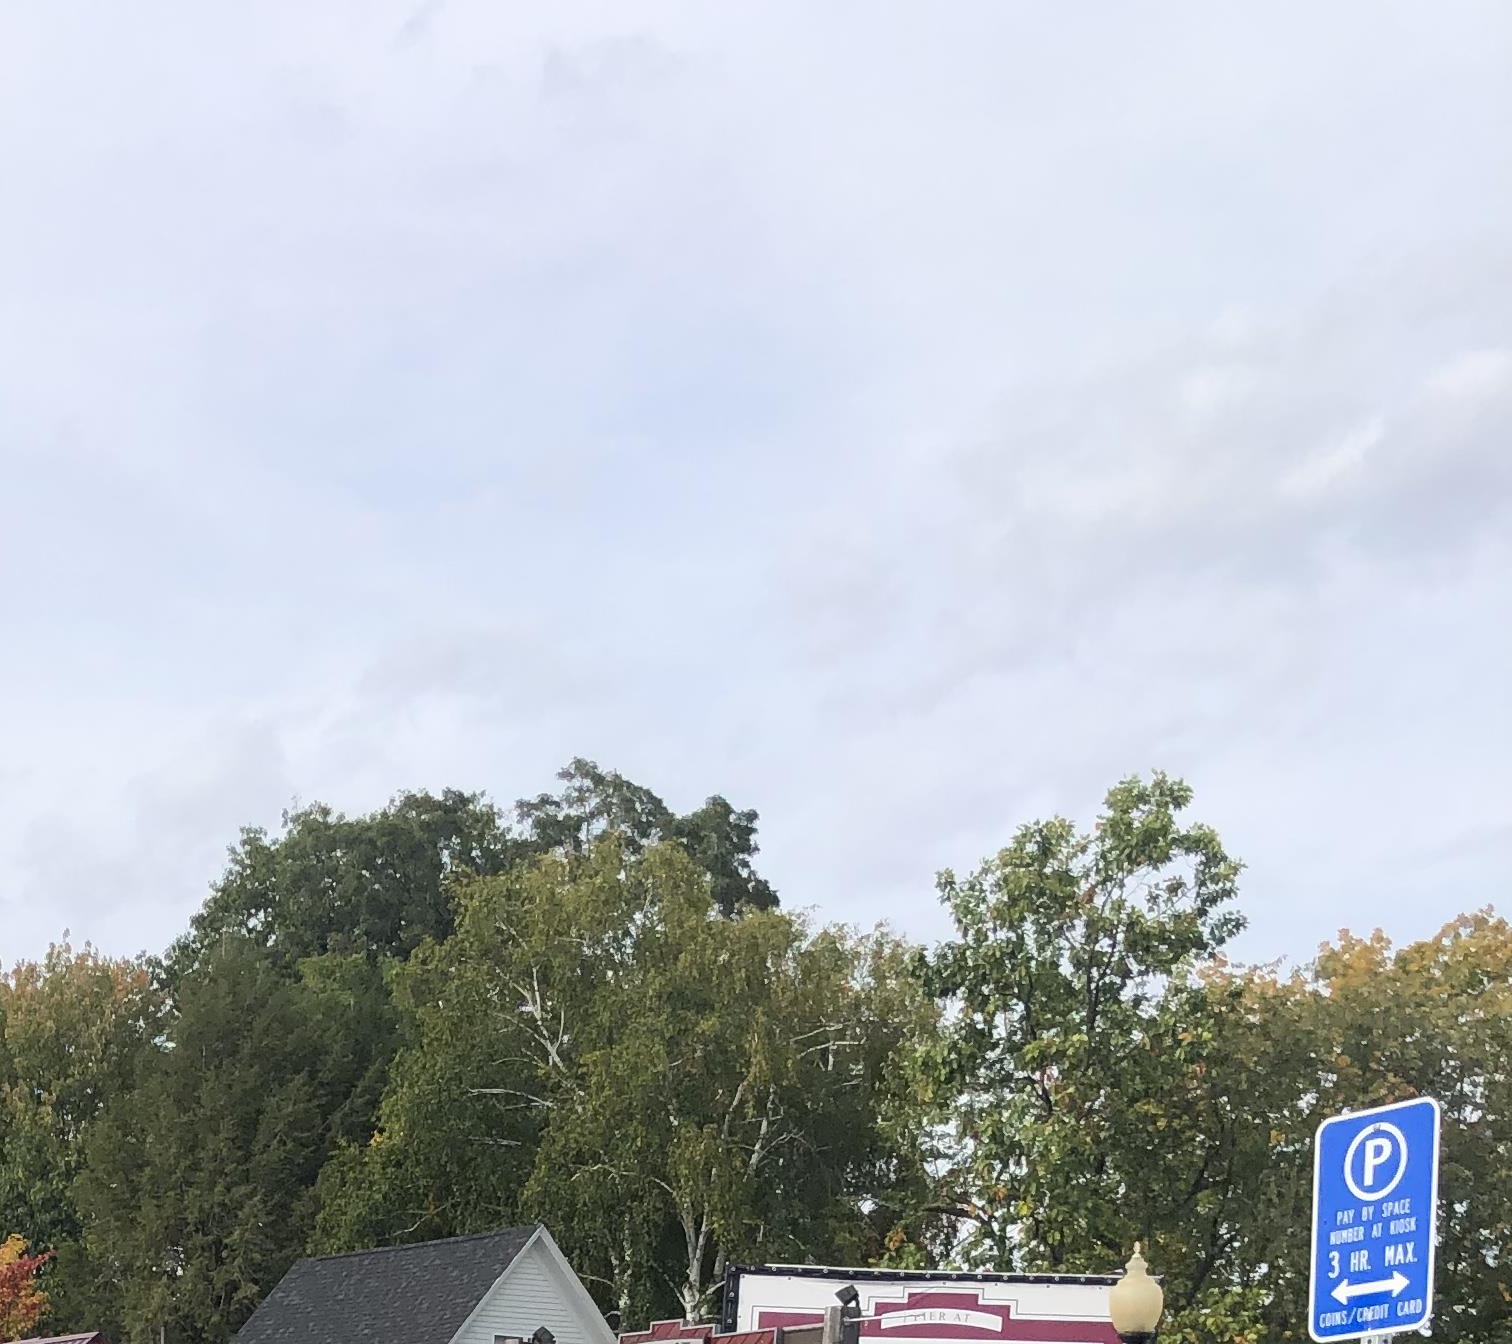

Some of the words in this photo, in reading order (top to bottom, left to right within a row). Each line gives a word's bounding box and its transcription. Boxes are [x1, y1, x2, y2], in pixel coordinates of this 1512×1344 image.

[1363, 1137, 1393, 1186] P
[1337, 1209, 1355, 1226] PAY
[1361, 1205, 1375, 1221] BY
[1382, 1199, 1411, 1218] SPACE
[1330, 1226, 1365, 1246] NUMBER
[1371, 1222, 1383, 1238] AT
[1390, 1217, 1417, 1235] KIOSK
[1328, 1250, 1341, 1278] 3
[1350, 1249, 1372, 1272] HR.
[1384, 1241, 1418, 1267] MAX.
[954, 1312, 972, 1324] AT
[1396, 1298, 1423, 1316] CARD
